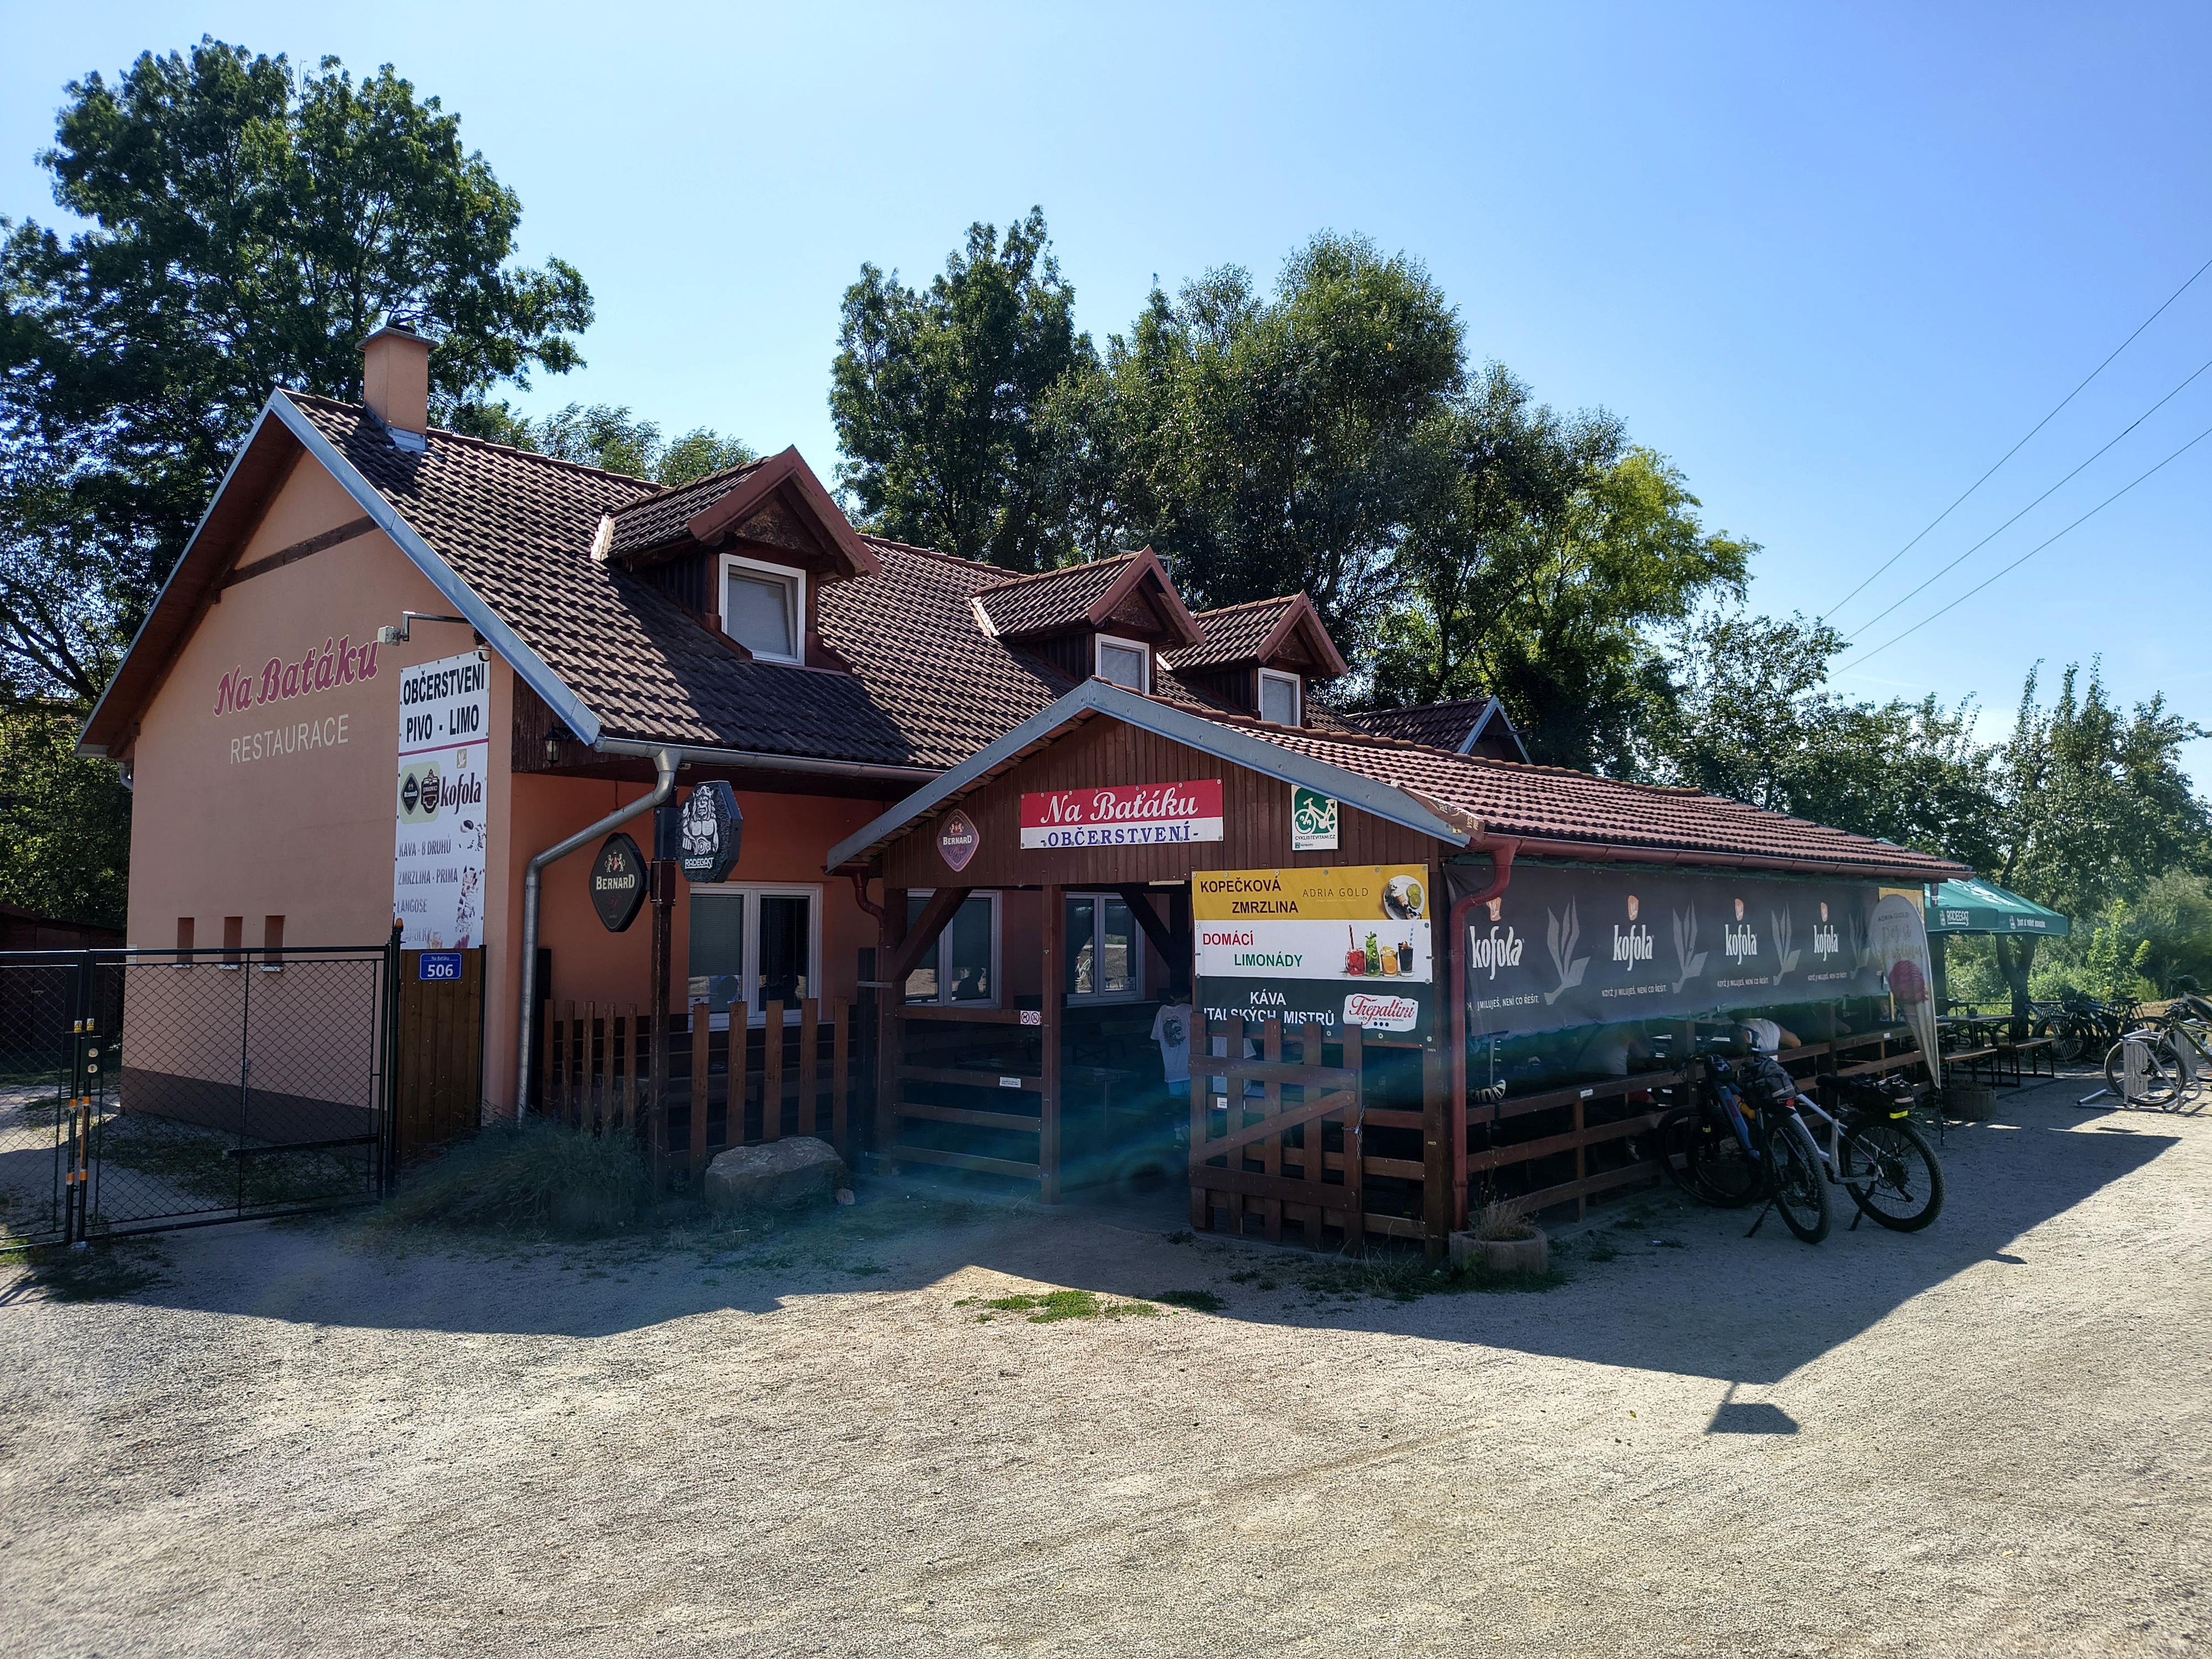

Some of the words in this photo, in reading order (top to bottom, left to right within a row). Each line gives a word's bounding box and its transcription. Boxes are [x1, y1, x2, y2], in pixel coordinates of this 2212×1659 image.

[214, 665, 253, 717] Na
[256, 634, 379, 706] Baťáku
[406, 713, 432, 743] PIVO
[449, 704, 479, 735] LIMO
[230, 714, 349, 764] RESTAURACE
[440, 772, 482, 815] kofola
[1040, 794, 1082, 823] Na
[1089, 787, 1198, 821] Baťáku
[399, 838, 416, 857] KÁVA
[421, 841, 426, 855] 8
[943, 835, 972, 846] BERNARD
[685, 857, 714, 869] RADEGAST
[398, 870, 431, 885] ZMRZLINA
[436, 868, 458, 884] PRIMA
[596, 874, 635, 890] BERNARD
[1200, 876, 1282, 893] KOPEČKOVÁ
[1302, 888, 1334, 897] ADRIA
[1339, 888, 1369, 897] GOLD
[1232, 901, 1299, 914] ZMRZLINA
[1947, 910, 1969, 926] RADEGAST
[1202, 931, 1254, 946] DOMÁCÍ
[1724, 924, 1757, 966] kofola
[1813, 925, 1839, 962] kofola
[1469, 926, 1524, 980] kofola
[1613, 924, 1653, 972] kofola
[1234, 951, 1303, 967] LIMONÁDY
[427, 964, 454, 978] 506
[1250, 989, 1287, 1005] KÁVA
[1503, 995, 1514, 1007] NENÍ
[1515, 997, 1523, 1005] CO
[1284, 1009, 1334, 1026] MISTRŮ
[1349, 995, 1415, 1025] Trepallini
